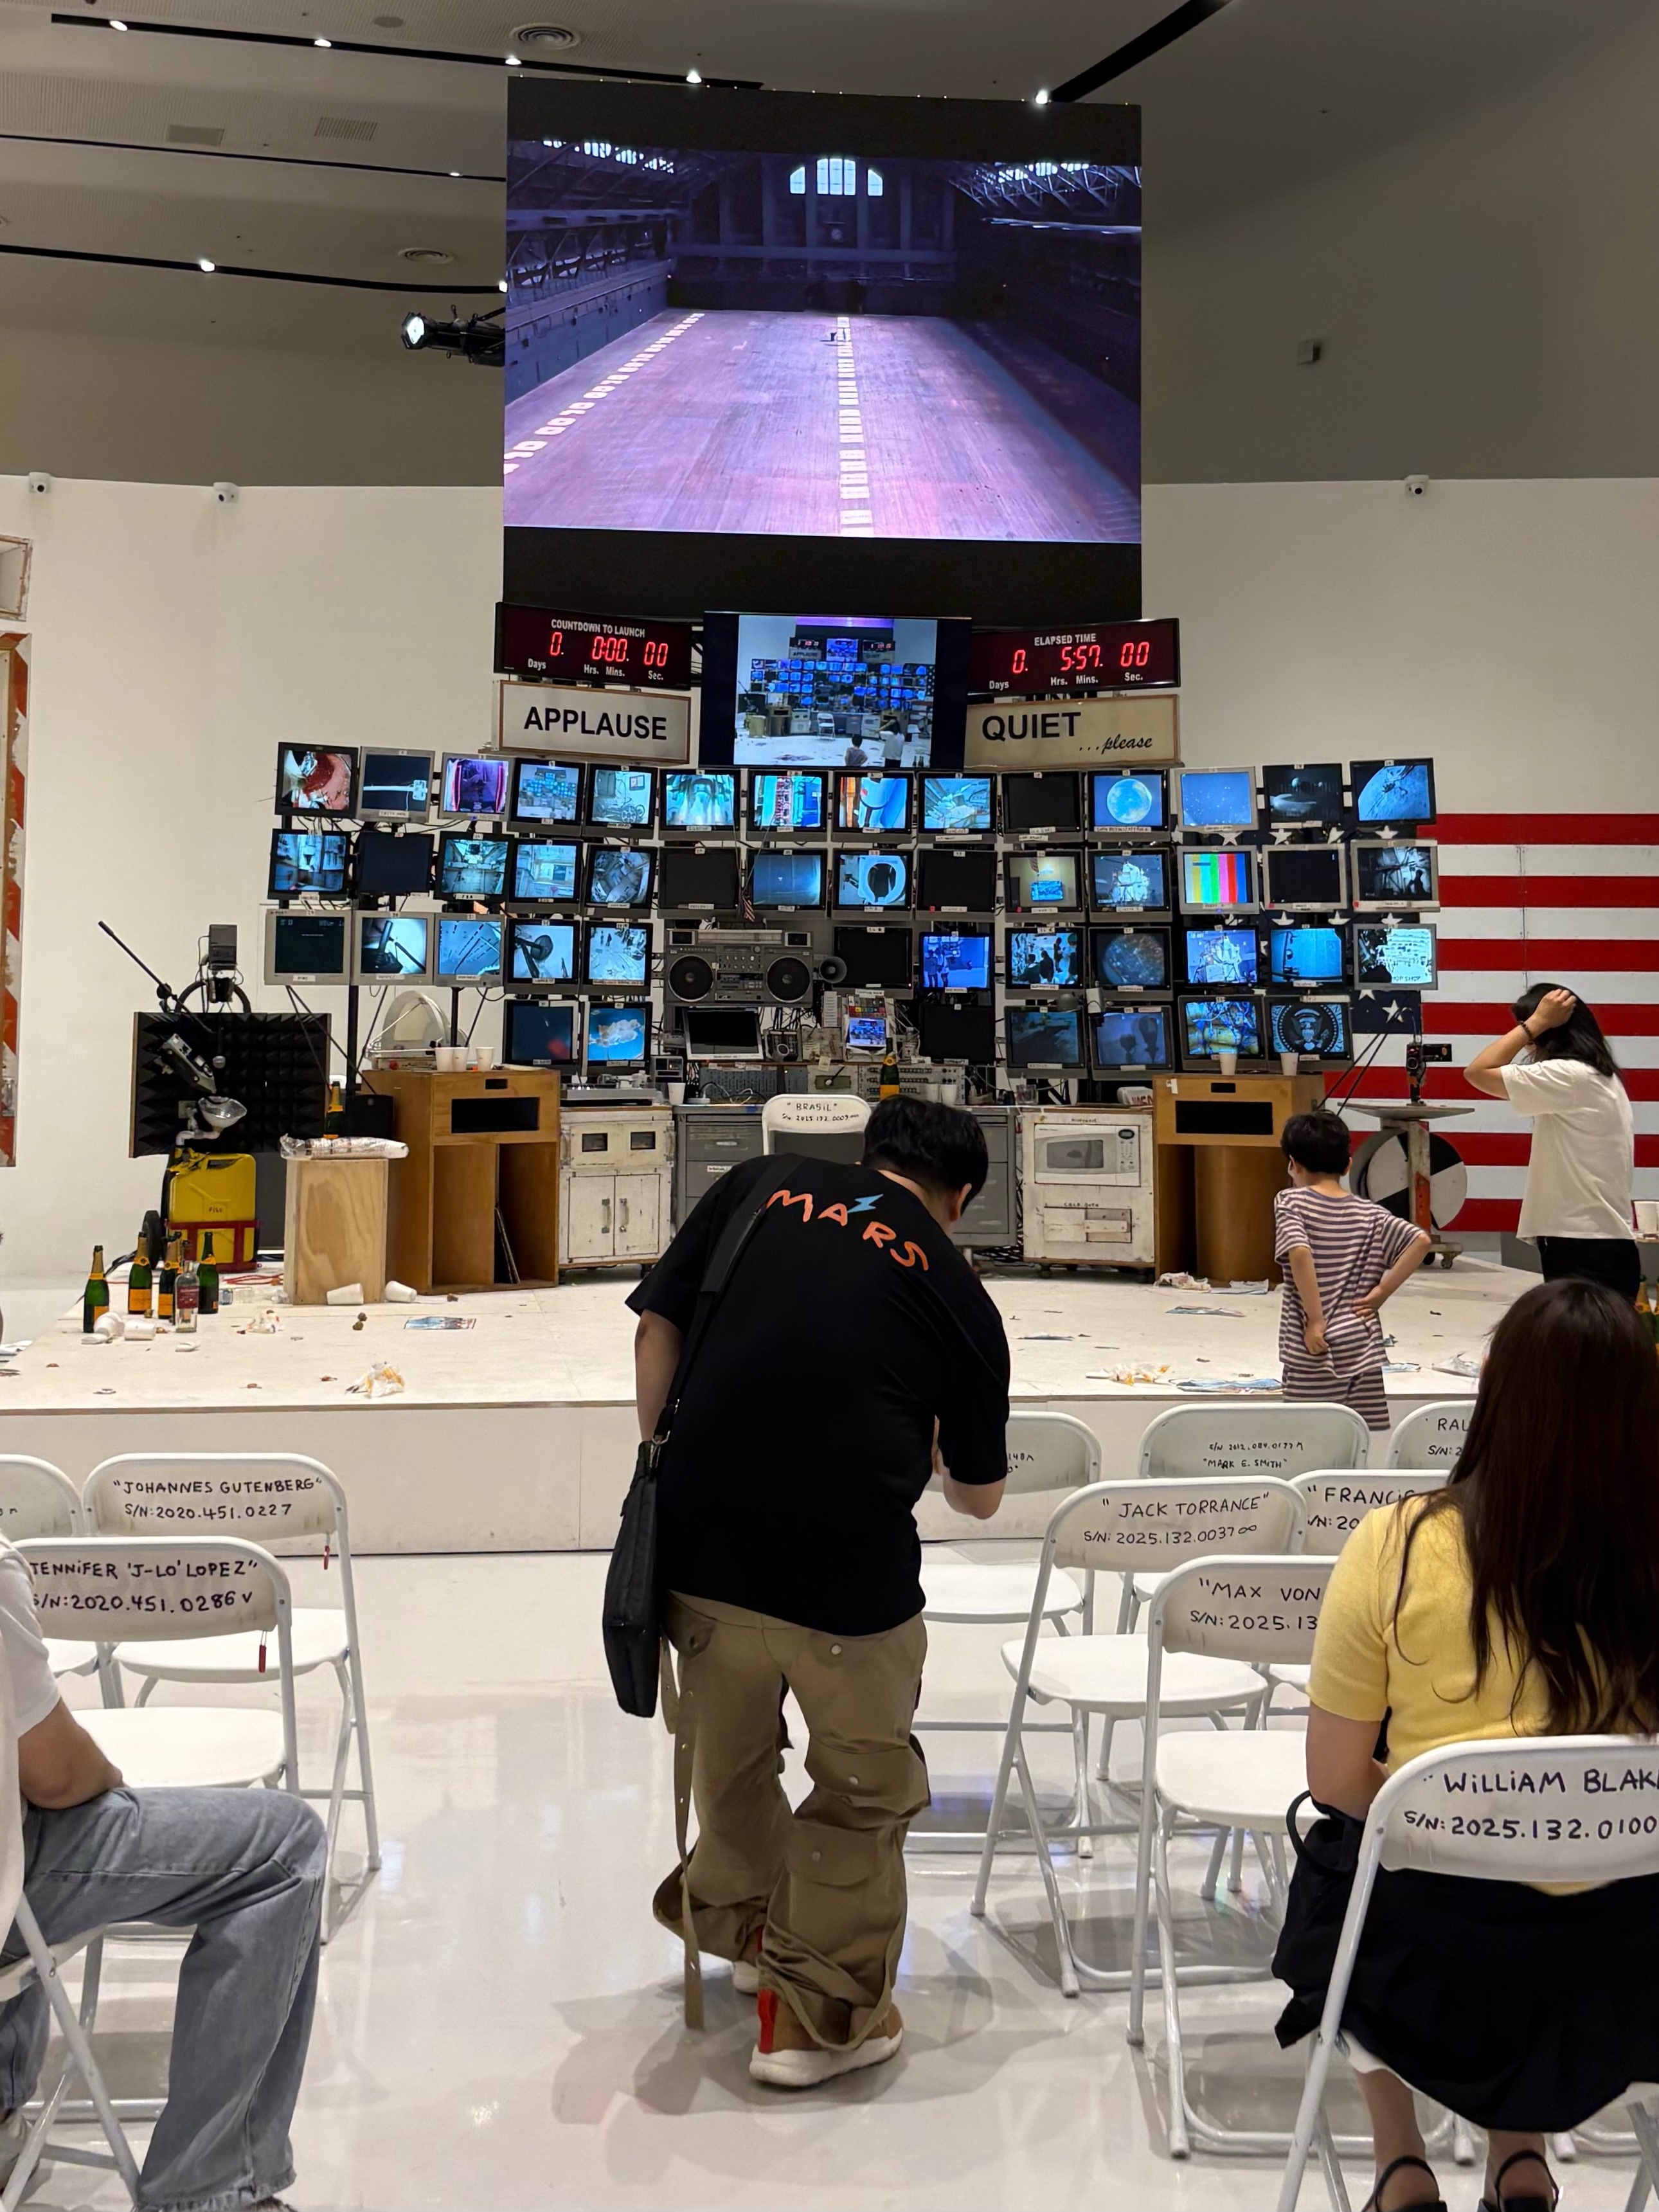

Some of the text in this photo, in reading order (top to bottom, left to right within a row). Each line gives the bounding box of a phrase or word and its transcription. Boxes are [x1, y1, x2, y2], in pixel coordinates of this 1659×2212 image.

[551, 619, 645, 638] COUNTDOWN TO LAUNCH
[1034, 633, 1097, 646] ELAPSED TIME
[528, 658, 663, 681] Days Hrs. Mins. Sec.
[989, 672, 1143, 691] Days Hrs. Mins. Sec.
[524, 706, 667, 740] APPLAUSE
[982, 712, 1081, 742] QUIET
[766, 1189, 929, 1272] MARS
[1280, 1587, 1320, 1601] VON
[1584, 1768, 1659, 1794] BLAK
